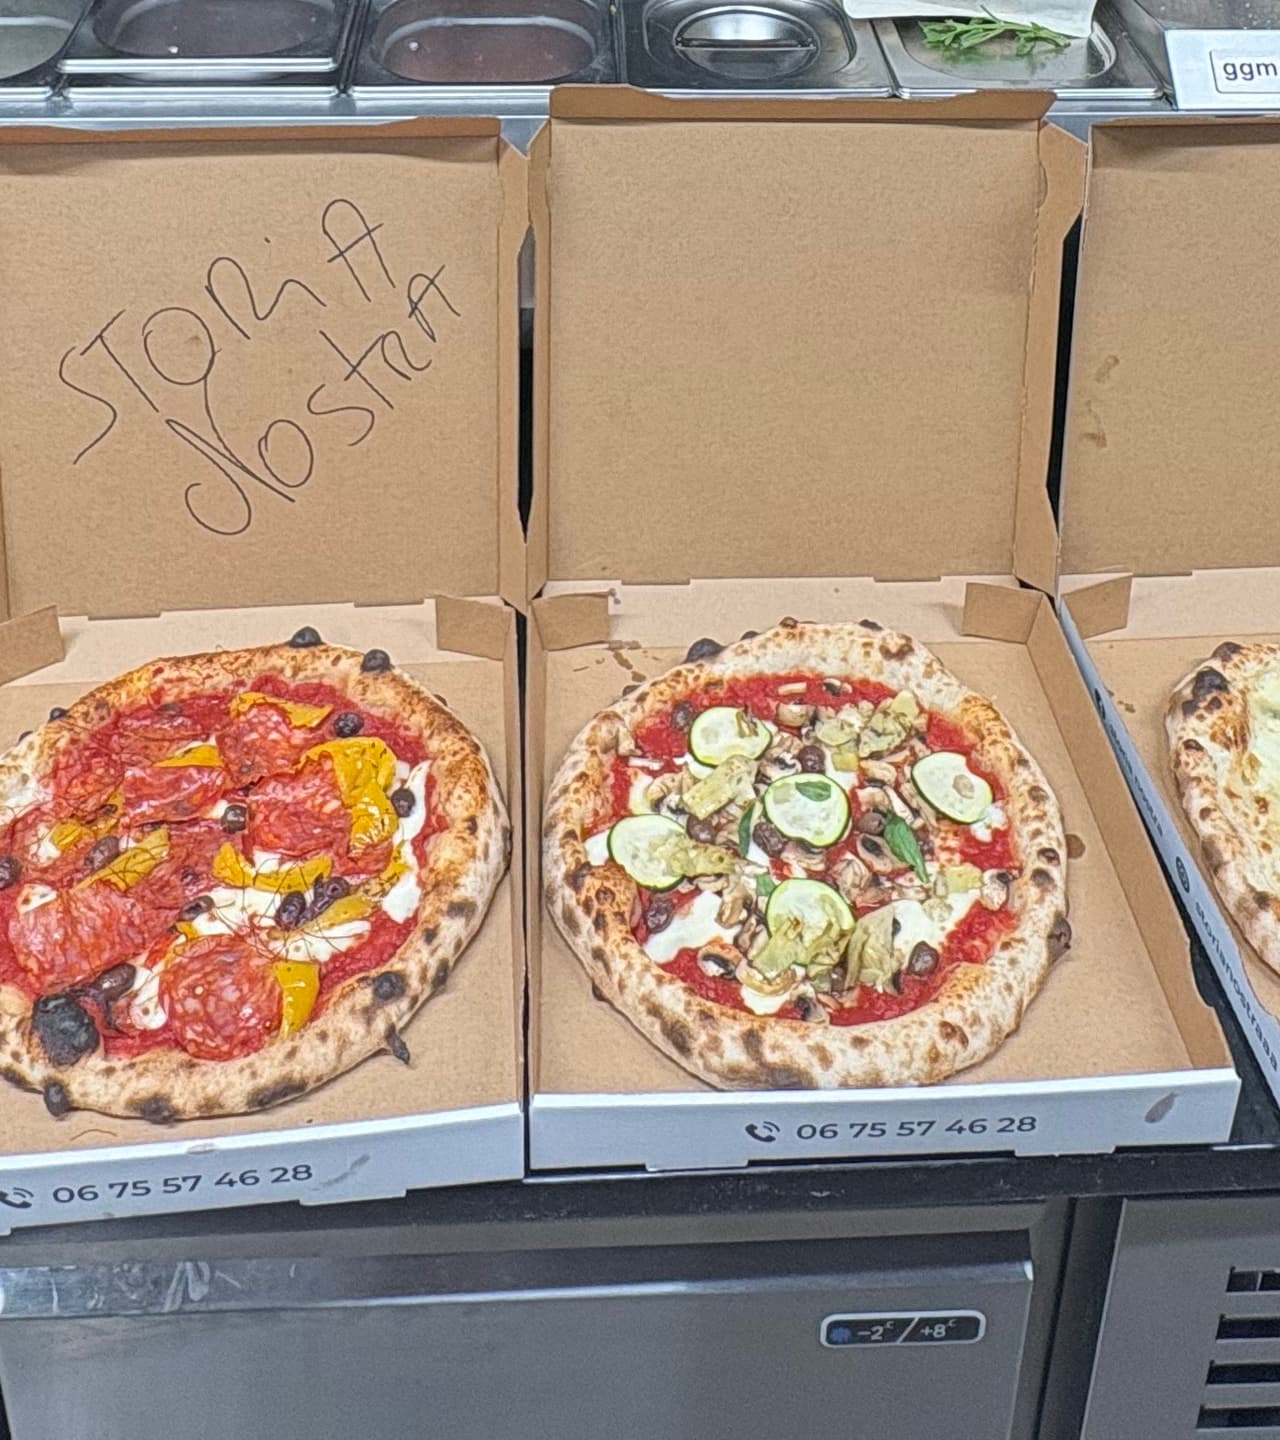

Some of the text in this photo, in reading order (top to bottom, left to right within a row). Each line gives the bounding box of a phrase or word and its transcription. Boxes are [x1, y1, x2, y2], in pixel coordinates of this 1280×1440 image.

[796, 1116, 1037, 1140] 06 75 57 46 28
[52, 1164, 313, 1204] 06 75 57 46 28
